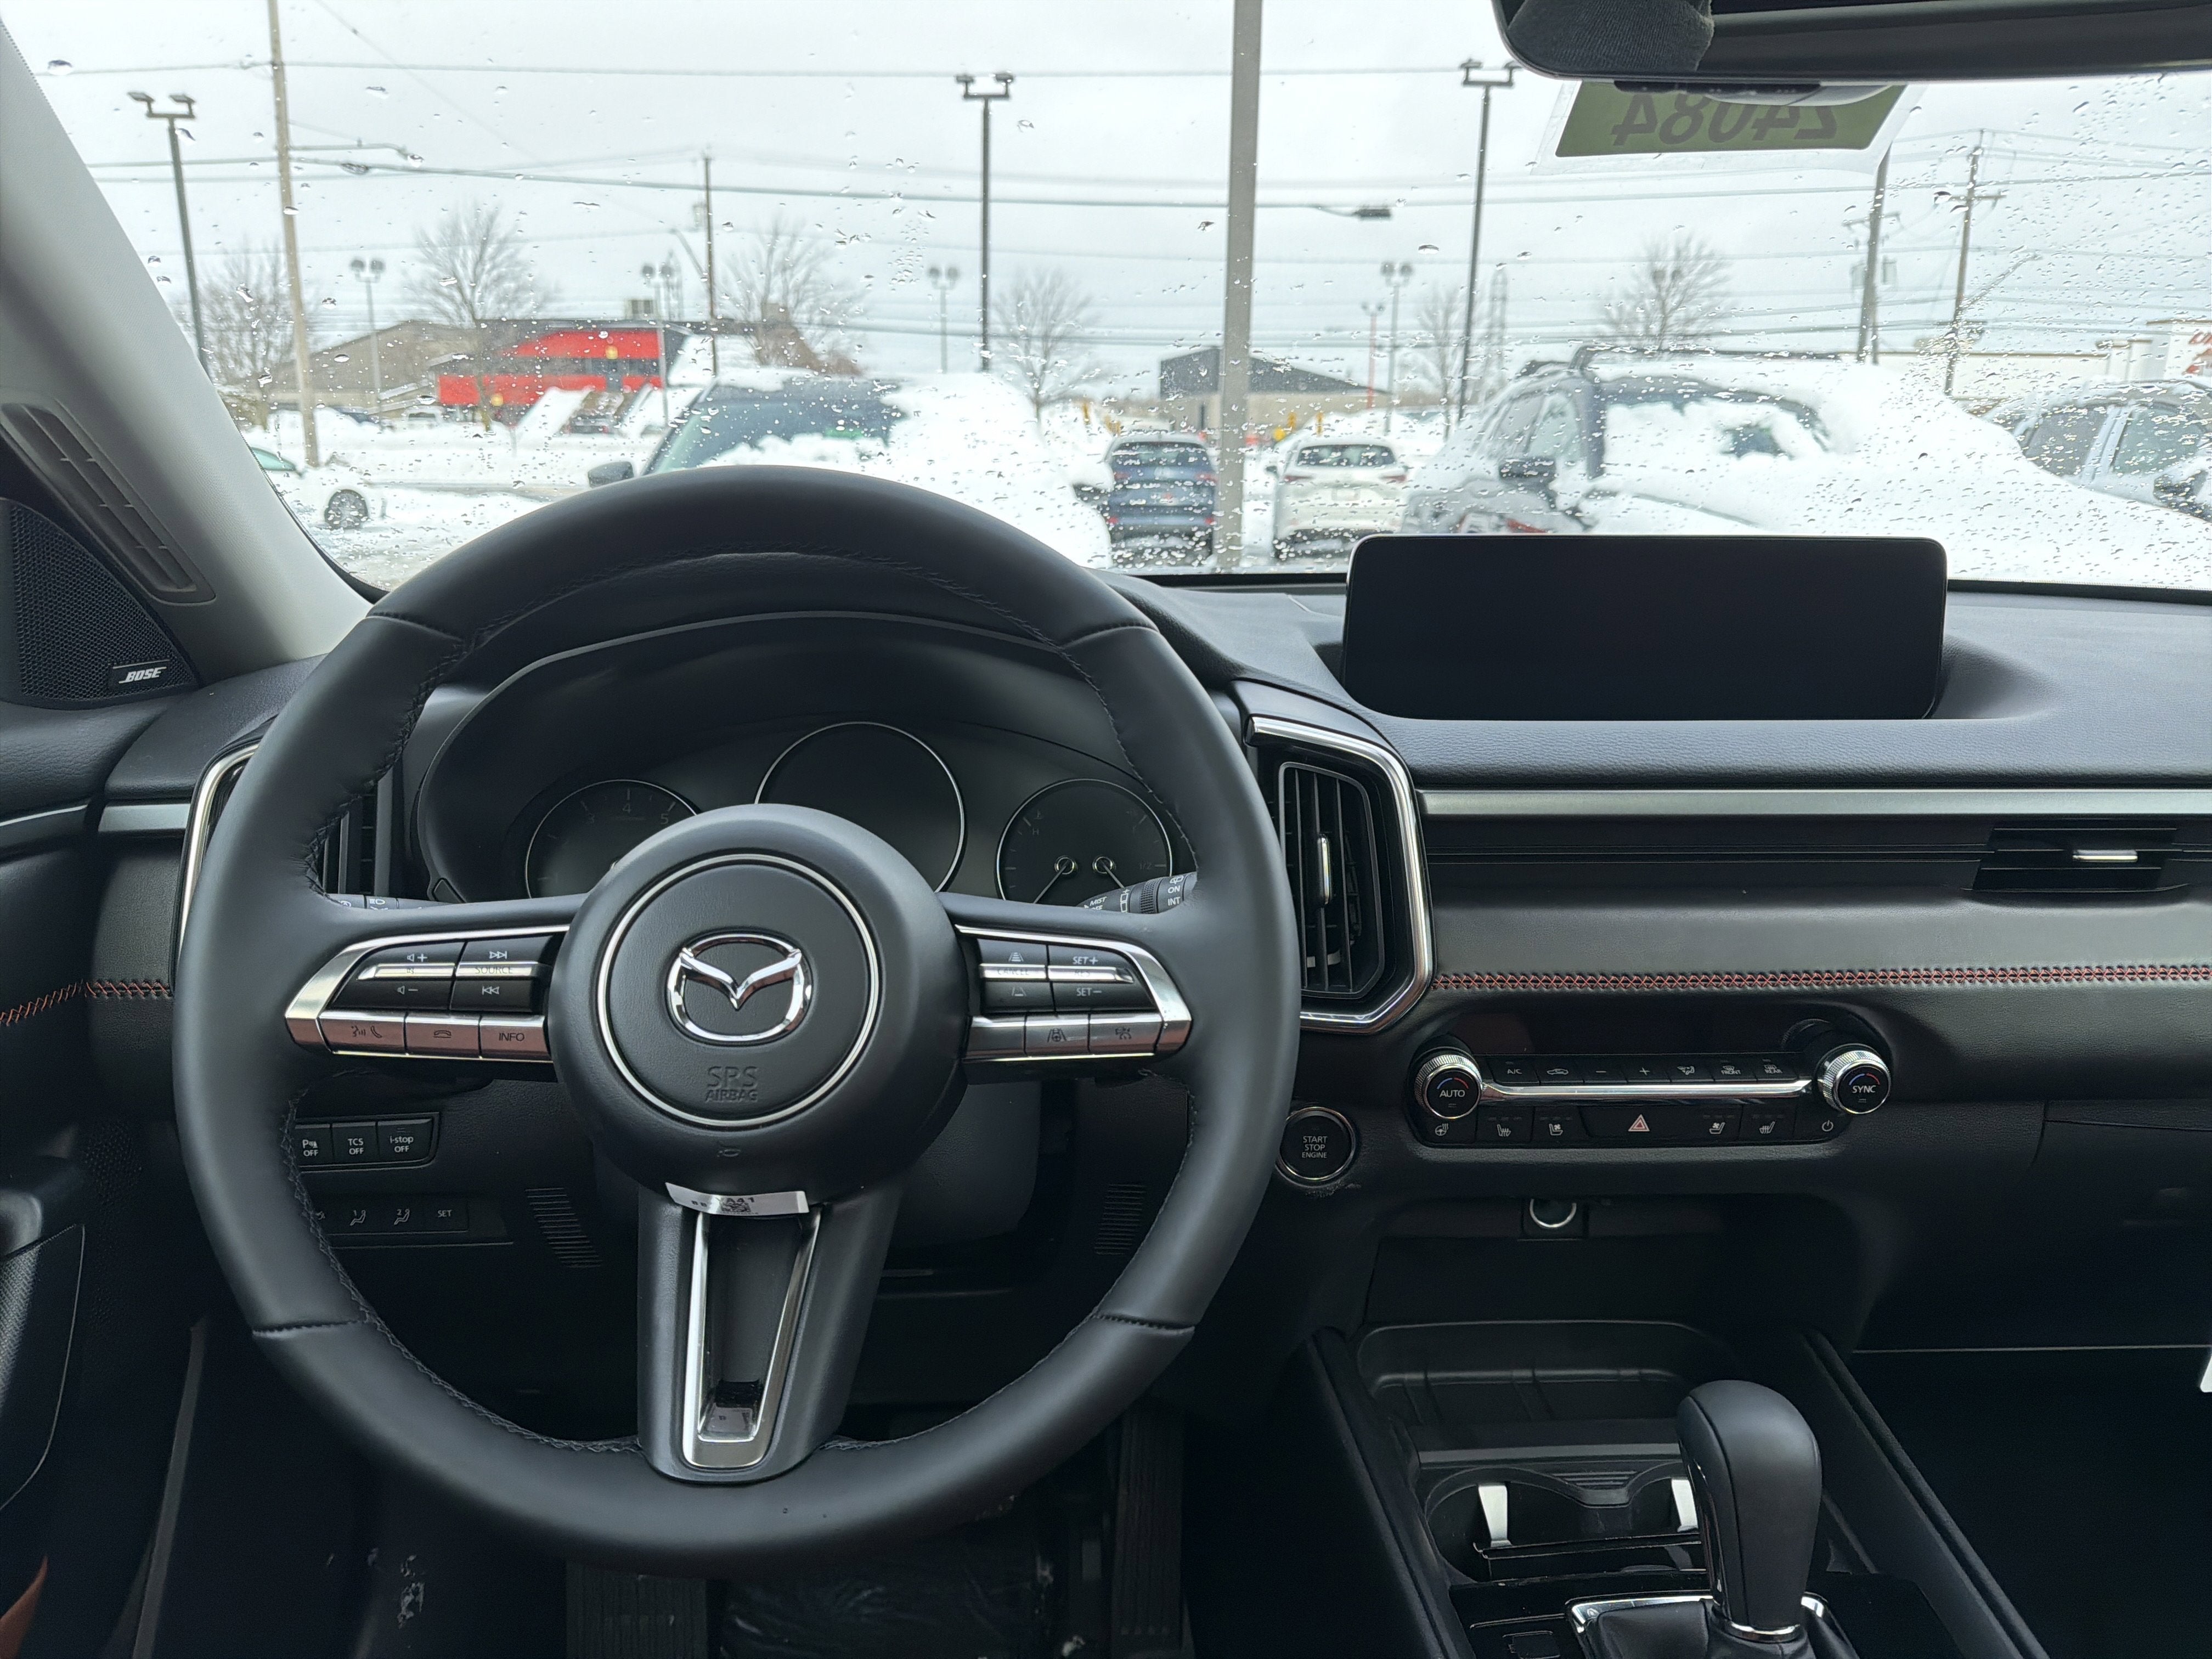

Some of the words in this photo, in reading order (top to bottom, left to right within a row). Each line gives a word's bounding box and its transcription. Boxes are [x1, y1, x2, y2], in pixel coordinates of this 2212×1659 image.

[119, 667, 167, 684] BOSE
[623, 803, 631, 813] 4
[661, 814, 668, 825] 5
[1167, 885, 1181, 894] ON
[1090, 896, 1107, 906] MIST
[1167, 896, 1181, 906] INT
[475, 966, 514, 974] SOURCE
[499, 1032, 525, 1041] INFO
[707, 1066, 758, 1088] SRS
[1851, 1085, 1877, 1093] SYNC
[704, 1089, 758, 1102] AIRBAG
[1439, 1090, 1465, 1098] AUTO
[347, 1138, 364, 1146] TCS
[390, 1136, 414, 1144] i-stop
